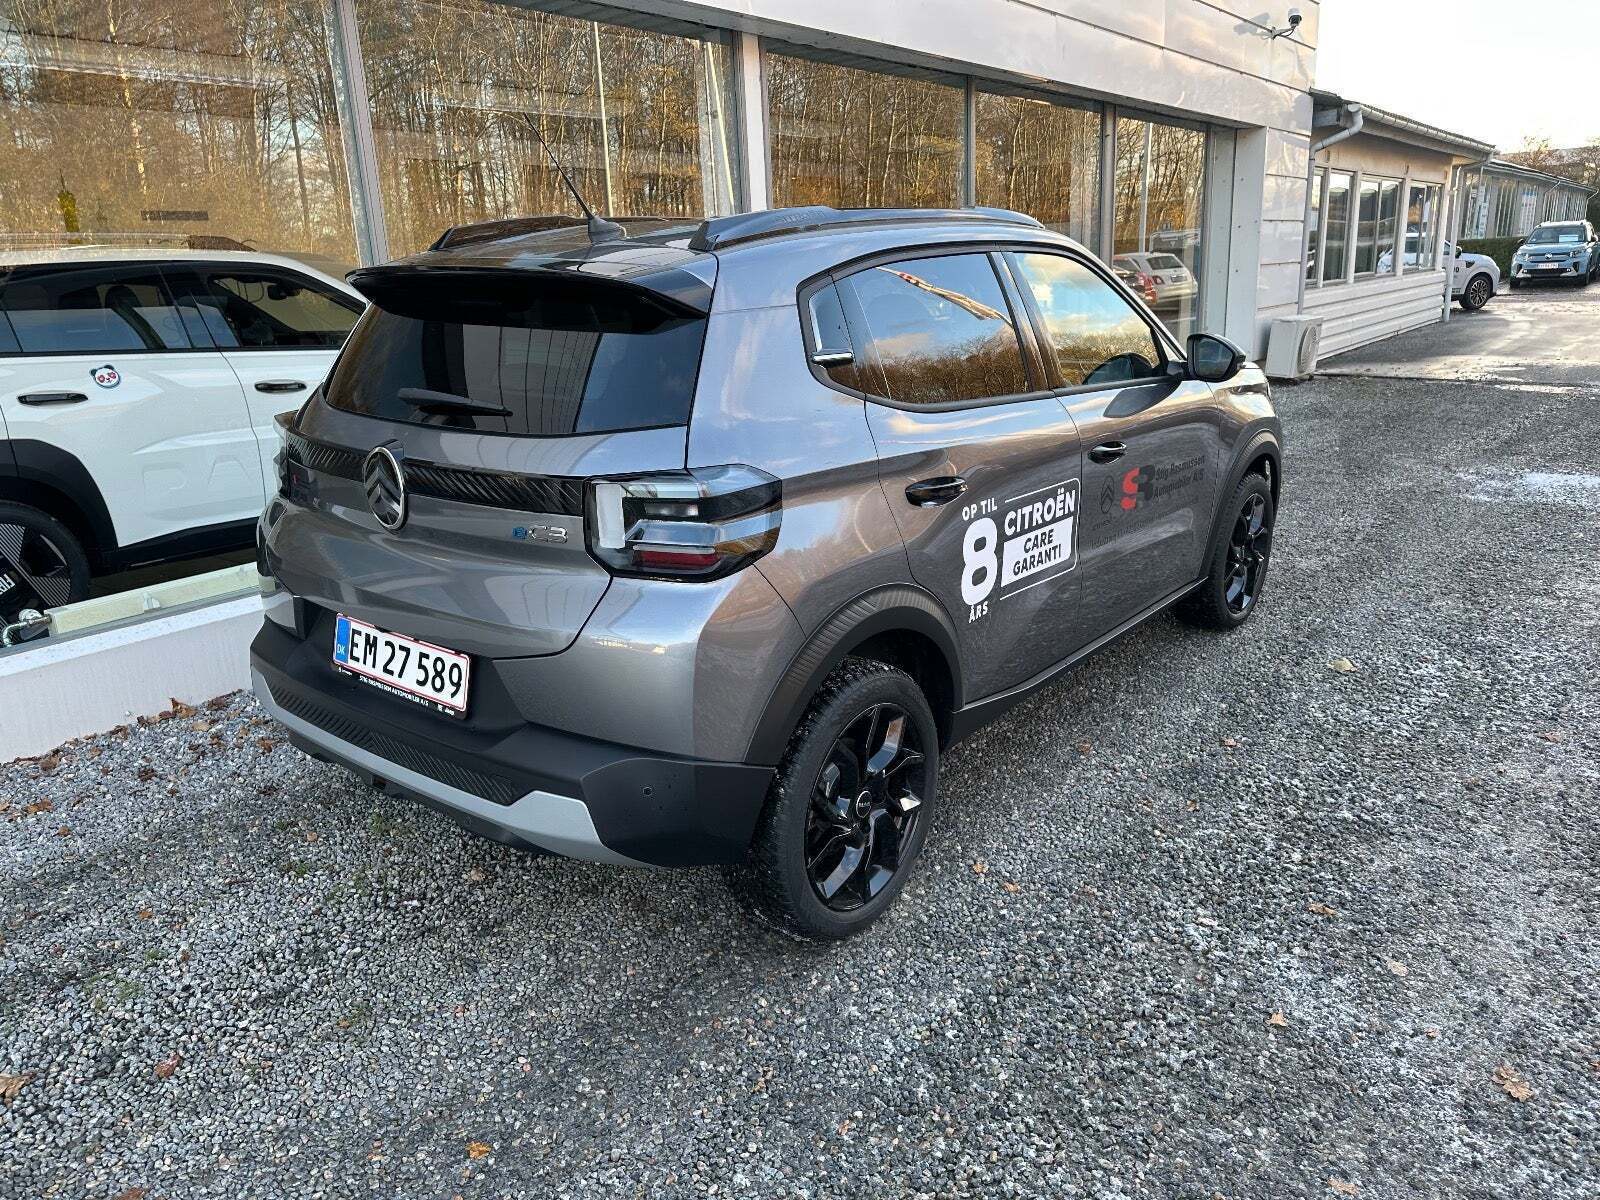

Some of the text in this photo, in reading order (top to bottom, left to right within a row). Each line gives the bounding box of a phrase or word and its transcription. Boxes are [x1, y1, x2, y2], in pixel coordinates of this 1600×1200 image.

[961, 497, 998, 521] OP TIL
[1004, 487, 1076, 536] CITROËN
[1023, 528, 1054, 554] CARE
[961, 517, 998, 606] 8
[1013, 543, 1062, 576] GARANTI
[968, 600, 989, 623] ÅRS
[337, 643, 346, 655] DK
[349, 628, 463, 699] EM 27 589
